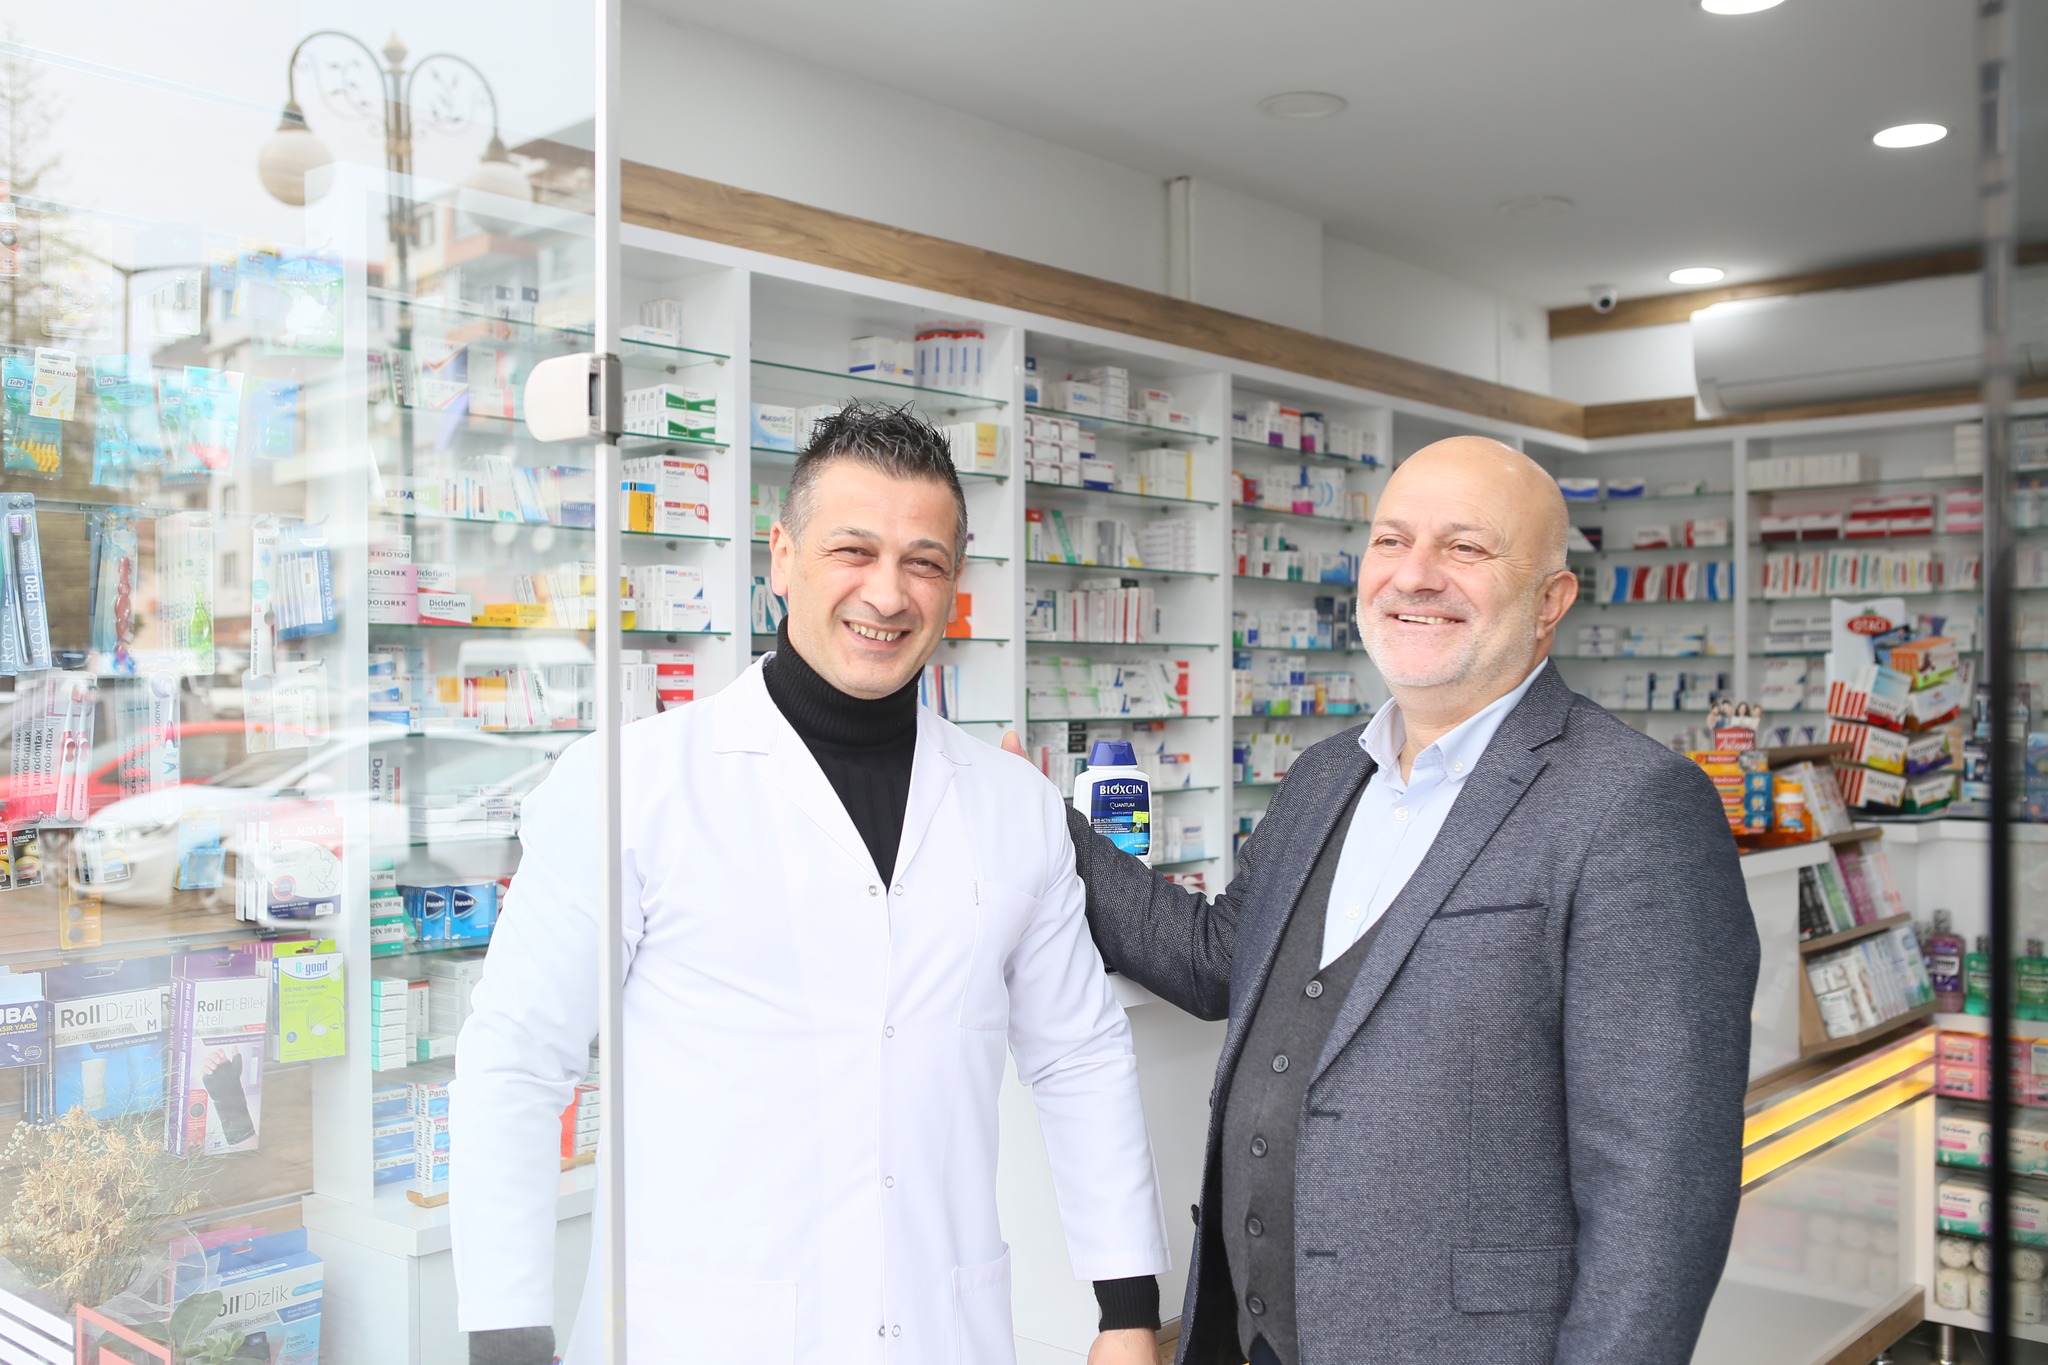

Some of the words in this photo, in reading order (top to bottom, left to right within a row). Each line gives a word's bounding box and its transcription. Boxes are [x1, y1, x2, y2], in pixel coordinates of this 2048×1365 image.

[24, 576, 39, 602] PRO
[430, 600, 466, 608] Dicloflam
[21, 730, 32, 787] parodontax
[33, 729, 43, 786] parodontax
[44, 727, 54, 784] parodontax
[1100, 784, 1143, 794] BIOXCIN
[296, 826, 316, 837] Milk
[319, 825, 336, 835] Box
[296, 960, 328, 976] B-good
[198, 999, 222, 1012] Roll
[225, 997, 265, 1011] El-Bilek
[61, 1004, 100, 1028] Roll
[106, 998, 152, 1022] Dizlik
[196, 1013, 224, 1026] Ateli
[147, 1019, 157, 1031] M
[217, 1295, 240, 1317] oll
[244, 1285, 289, 1310] Dizlik
[244, 1314, 271, 1327] Bedenli
